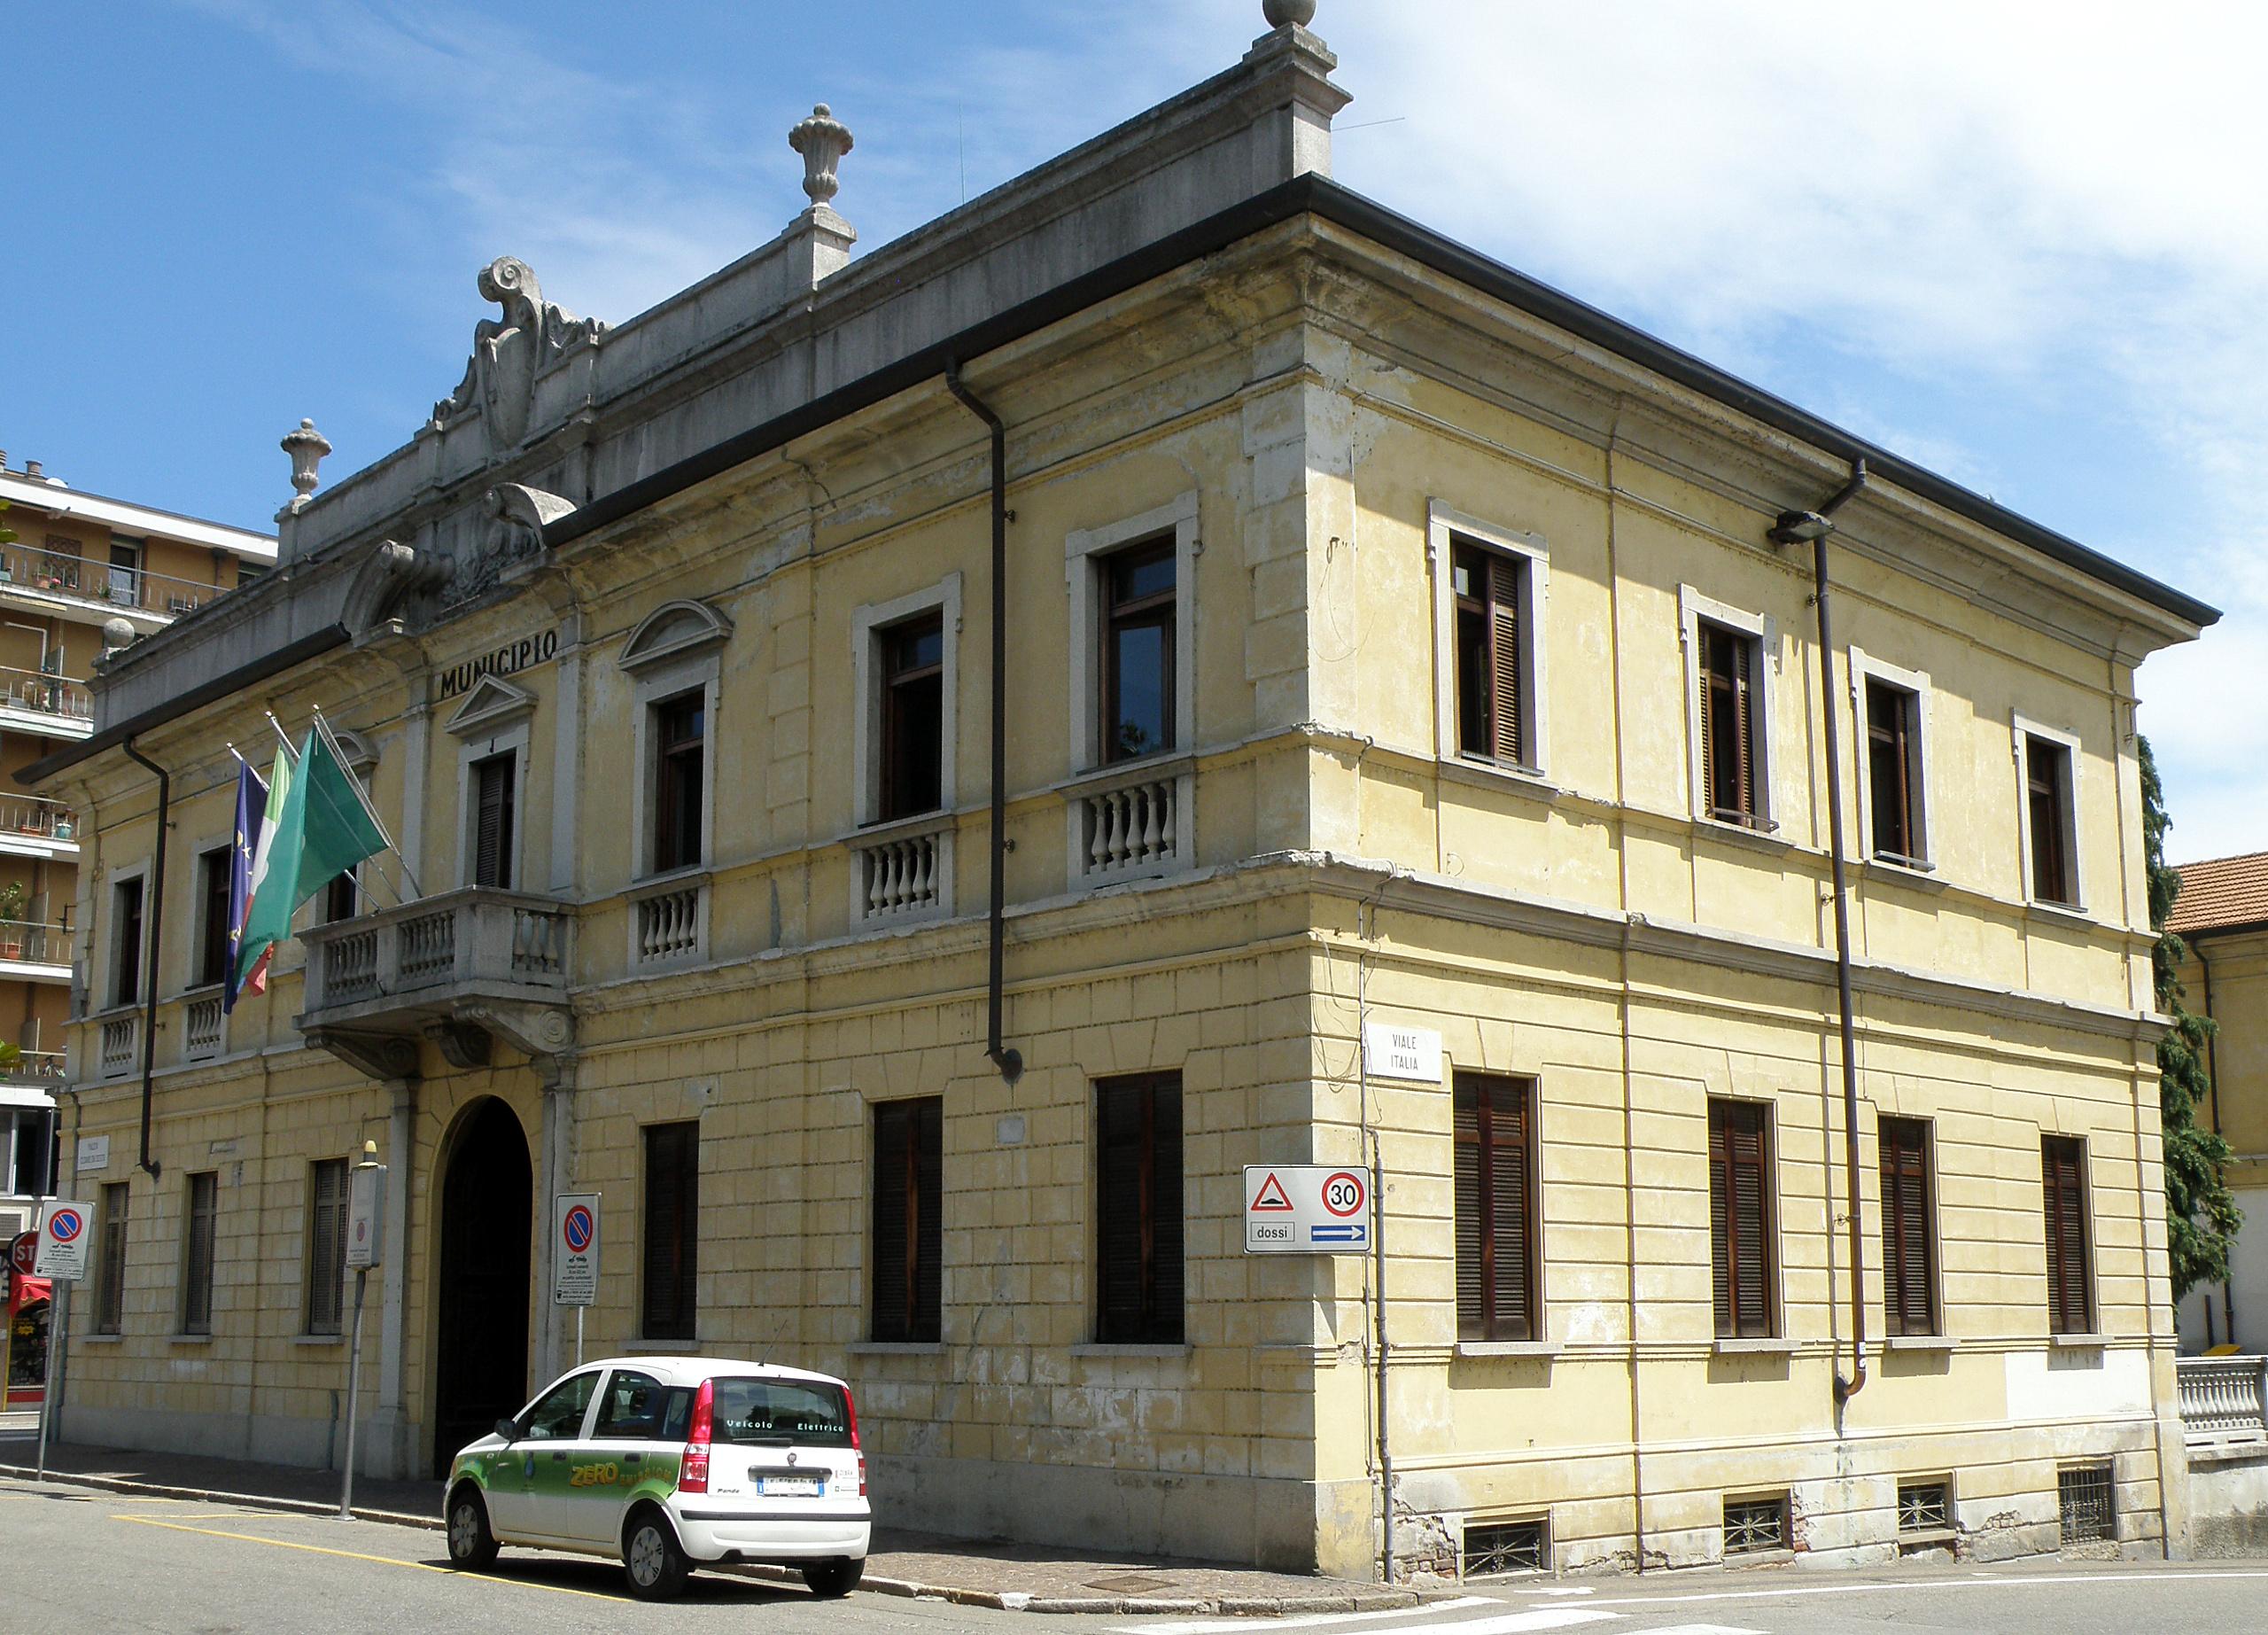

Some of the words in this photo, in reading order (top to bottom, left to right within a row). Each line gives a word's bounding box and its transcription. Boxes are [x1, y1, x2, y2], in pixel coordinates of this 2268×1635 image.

[440, 630, 558, 700] MUNICIPIO
[1392, 1033, 1417, 1050] VIALE
[1390, 1054, 1418, 1071] ITALIA
[1331, 1184, 1356, 1205] 30
[1257, 1226, 1287, 1239] dossi
[16, 1245, 35, 1262] ST
[726, 1420, 773, 1429] Veicolo
[797, 1423, 843, 1432] Elettrico
[570, 1462, 618, 1488] ZERO
